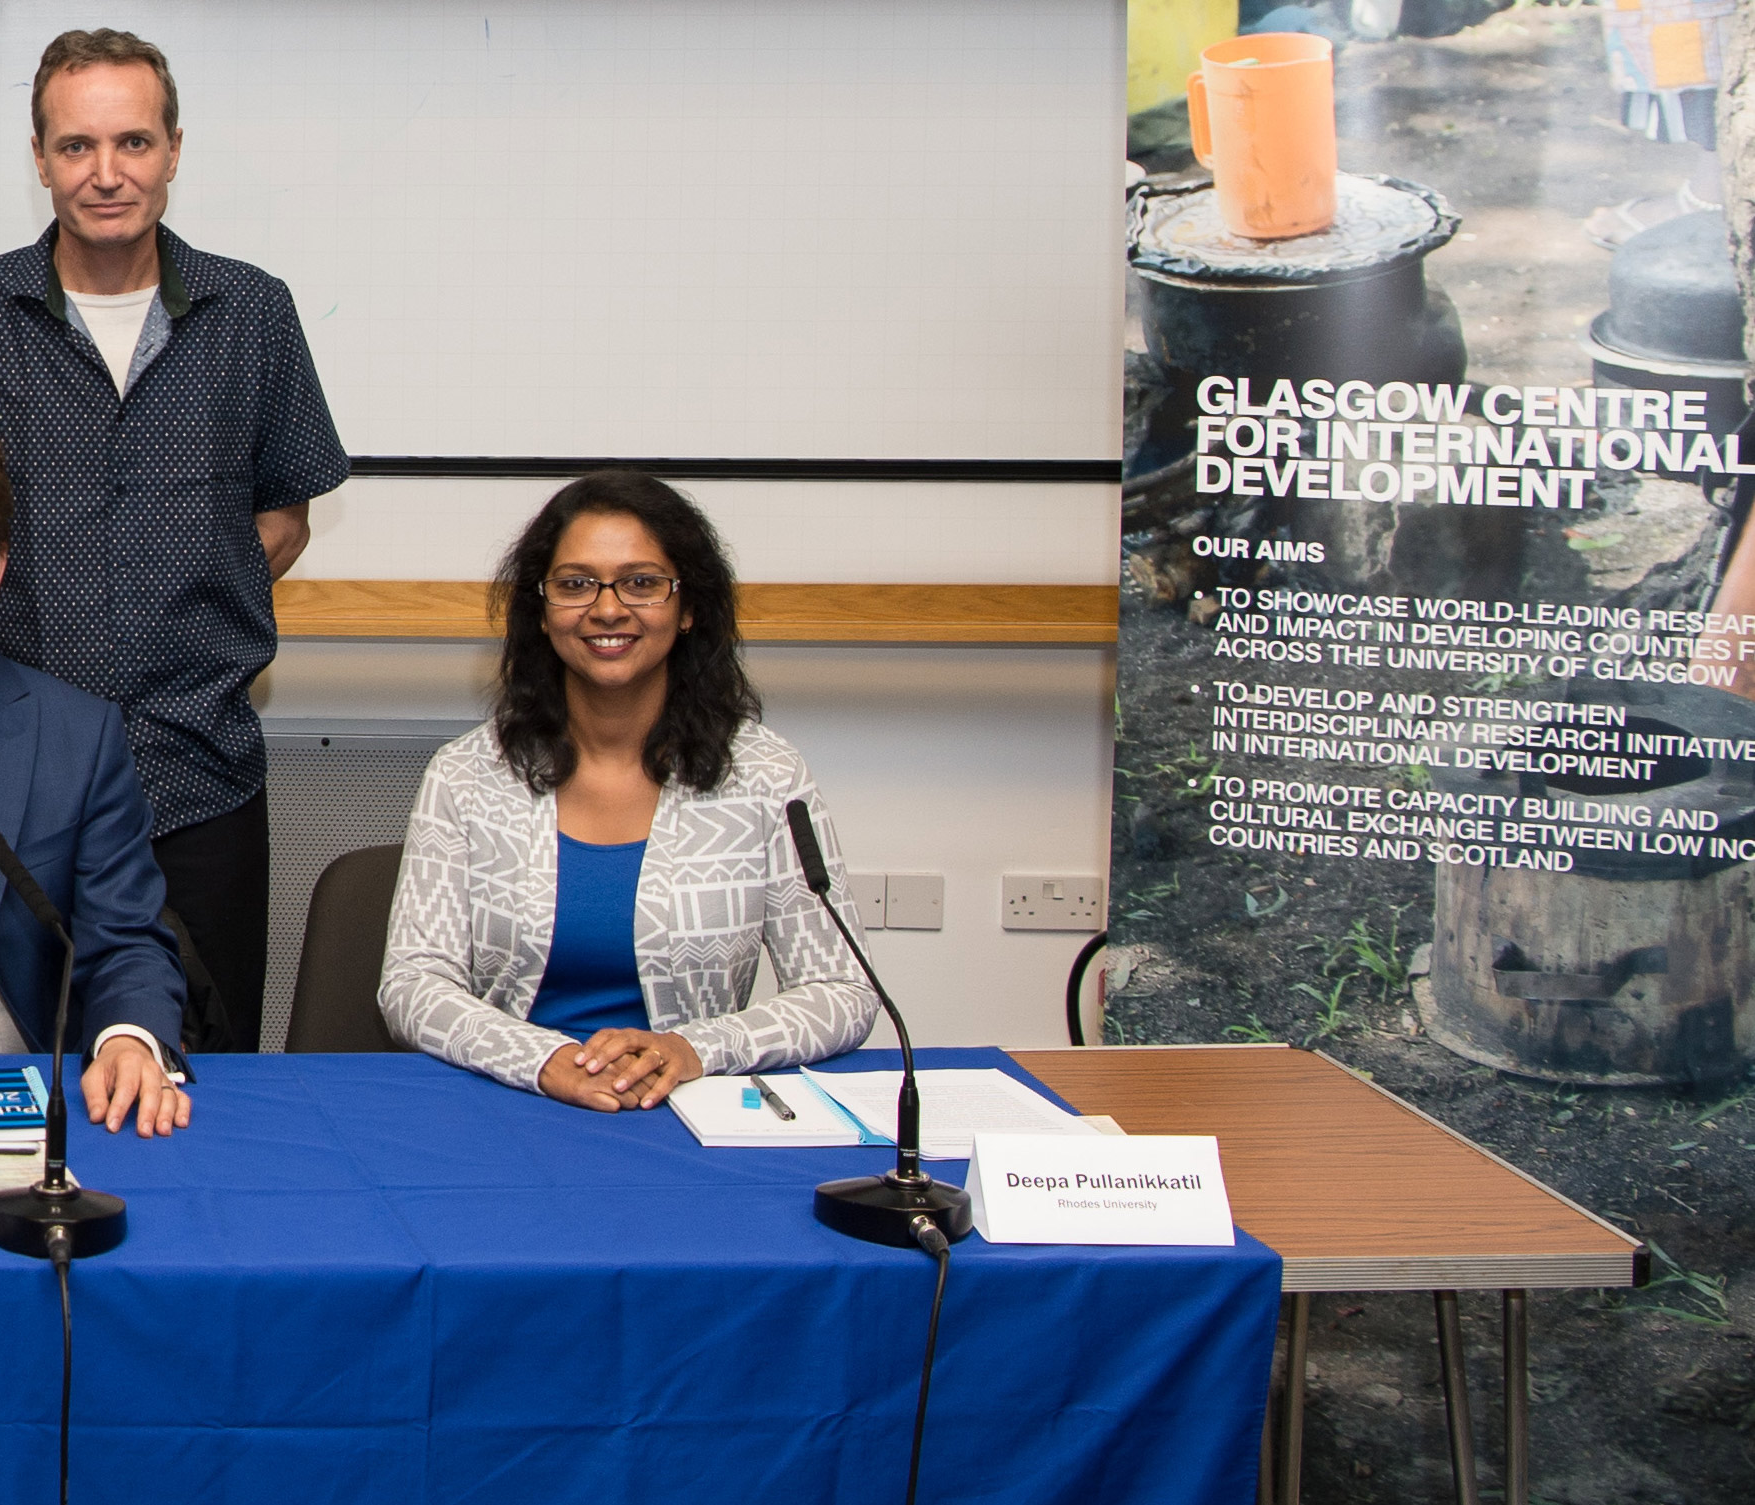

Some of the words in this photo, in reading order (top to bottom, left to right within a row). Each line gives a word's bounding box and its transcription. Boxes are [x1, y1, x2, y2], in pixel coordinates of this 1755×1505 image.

[1196, 375, 1471, 422] GLASGOW
[1482, 384, 1708, 431] CENTRE
[1197, 415, 1302, 457] FOR
[1316, 420, 1755, 475] INTERNATIONAL
[1196, 455, 1596, 509] DEVELOPMENT
[1192, 536, 1250, 559] OUR
[1255, 540, 1325, 564] AIMS
[1216, 586, 1251, 609] TO
[1257, 589, 1409, 618] SHOWCASE
[1414, 598, 1642, 630] WORLD-LEADING
[1214, 612, 1269, 635] AND
[1275, 616, 1372, 641] IMPACT
[1378, 622, 1404, 643] IN
[1411, 623, 1582, 653] DEVELOPING
[1588, 632, 1732, 662] COUNTIES
[1214, 637, 1322, 663] ACROSS
[1328, 644, 1380, 667] THE
[1387, 648, 1543, 675] UNIVERSITY
[1548, 655, 1588, 678] OF
[1593, 658, 1737, 687] GLASGOW
[1213, 681, 1249, 703] TO
[1254, 684, 1374, 711] DEVELOP
[1379, 692, 1437, 716] AND
[1442, 695, 1627, 727] STRENGTHEN
[1212, 731, 1237, 752] IN
[1243, 734, 1450, 767] INTERNATIONAL
[1455, 747, 1658, 781] DEVELOPMENT
[1213, 705, 1466, 743] INTERDISCIPLINARY
[1472, 723, 1620, 753] RESEARCH
[1627, 732, 1755, 762] INITIATIVE
[1209, 800, 1342, 831] CULTURAL
[1347, 811, 1494, 841] EXCHANGE
[1500, 821, 1634, 852] BETWEEN
[1640, 831, 1705, 857] LOW
[1210, 775, 1246, 798] TO
[1252, 779, 1382, 808] PROMOTE
[1387, 789, 1518, 817] CAPACITY
[1523, 797, 1652, 827] BUILDING
[1658, 807, 1719, 832] AND
[1208, 825, 1358, 857] COUNTRIES
[1363, 838, 1421, 861] AND
[1426, 843, 1574, 873] SCOTLAND
[1005, 1172, 1069, 1191] Deepa
[1075, 1173, 1202, 1190] Pullanikkatil
[1057, 1198, 1101, 1209] Rhodes
[1103, 1199, 1158, 1211] University
